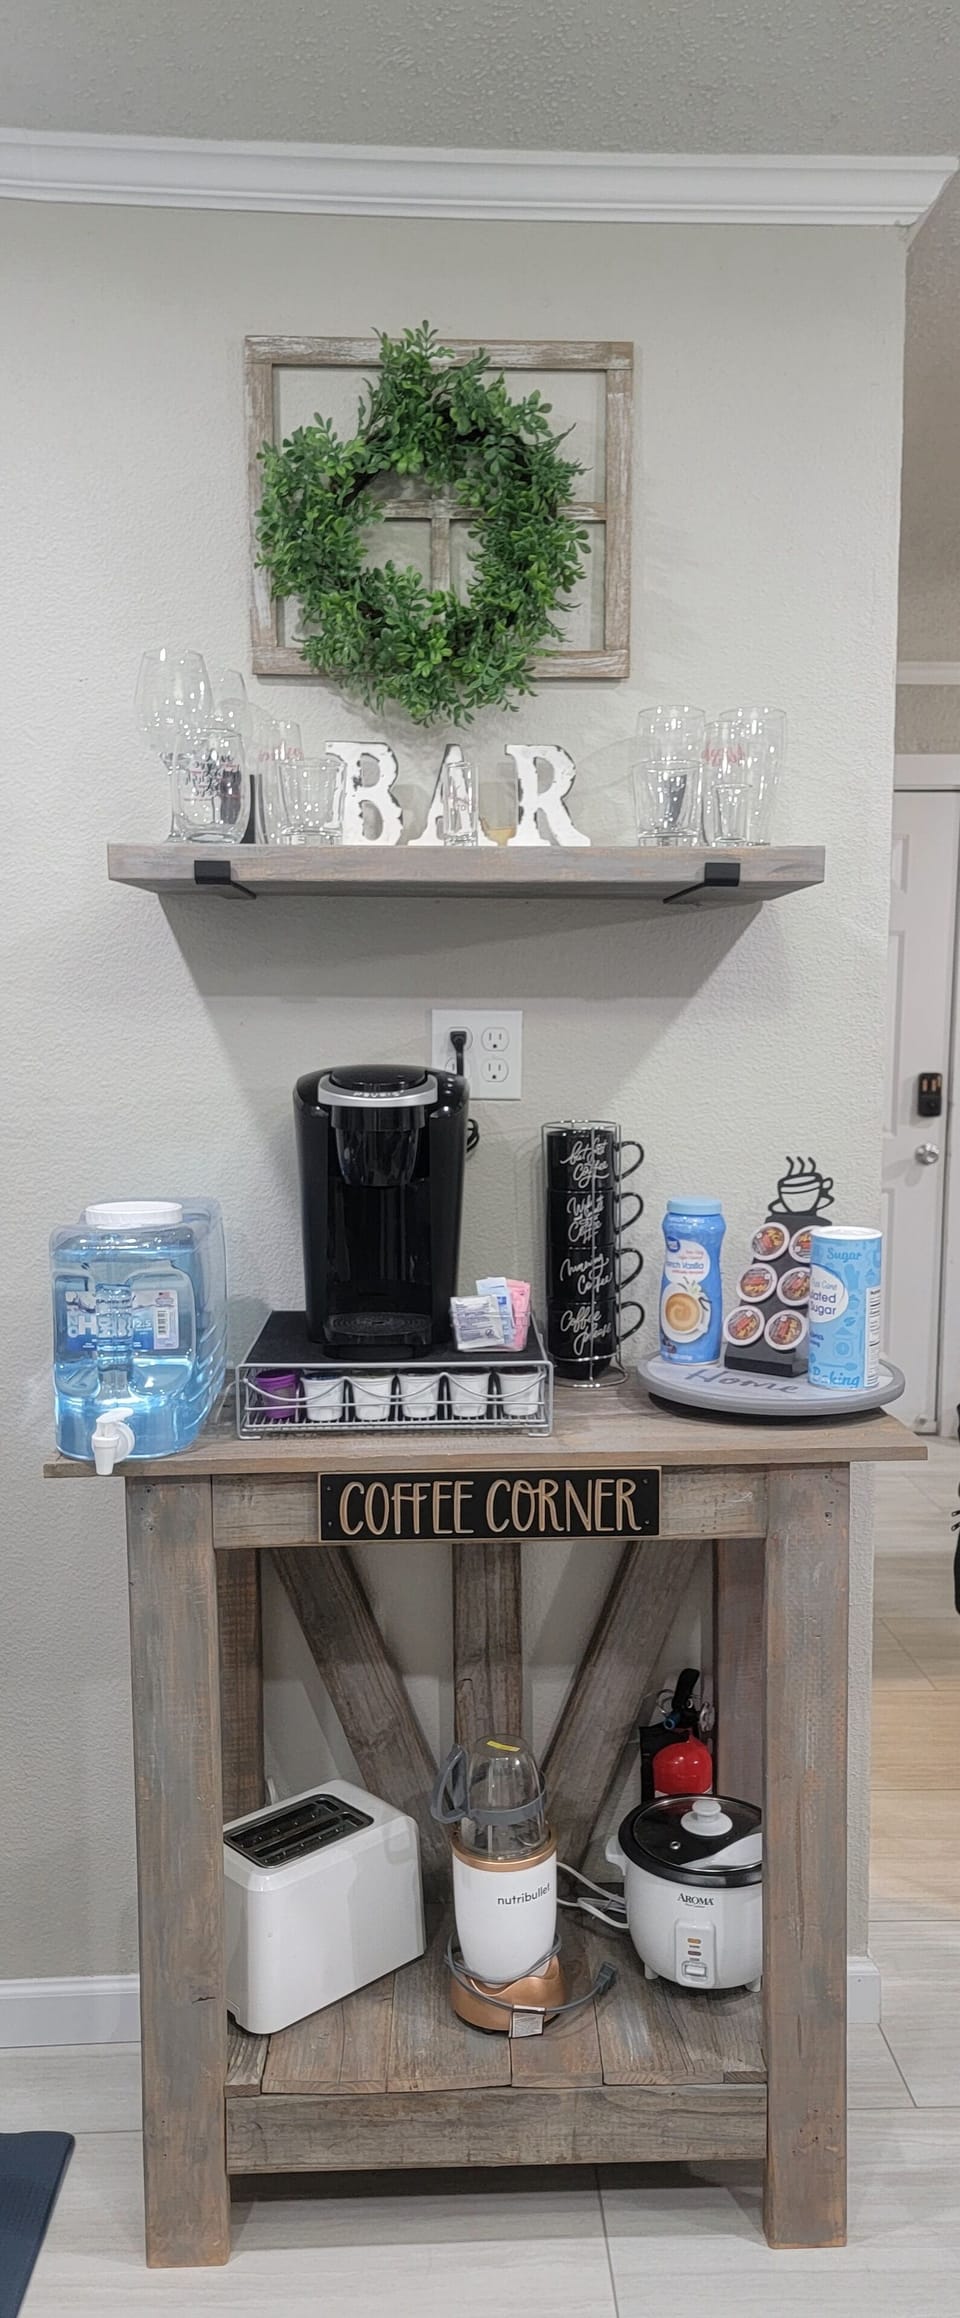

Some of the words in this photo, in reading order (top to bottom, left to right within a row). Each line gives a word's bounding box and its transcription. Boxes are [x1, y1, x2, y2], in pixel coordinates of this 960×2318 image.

[325, 740, 591, 847] BAR
[826, 1247, 862, 1263] Sugar
[685, 1368, 799, 1394] Home
[339, 1480, 475, 1536] COFFEE
[486, 1479, 642, 1533] CORNER
[497, 1882, 550, 1905] nutribullet
[677, 1893, 714, 1906] AROMA
